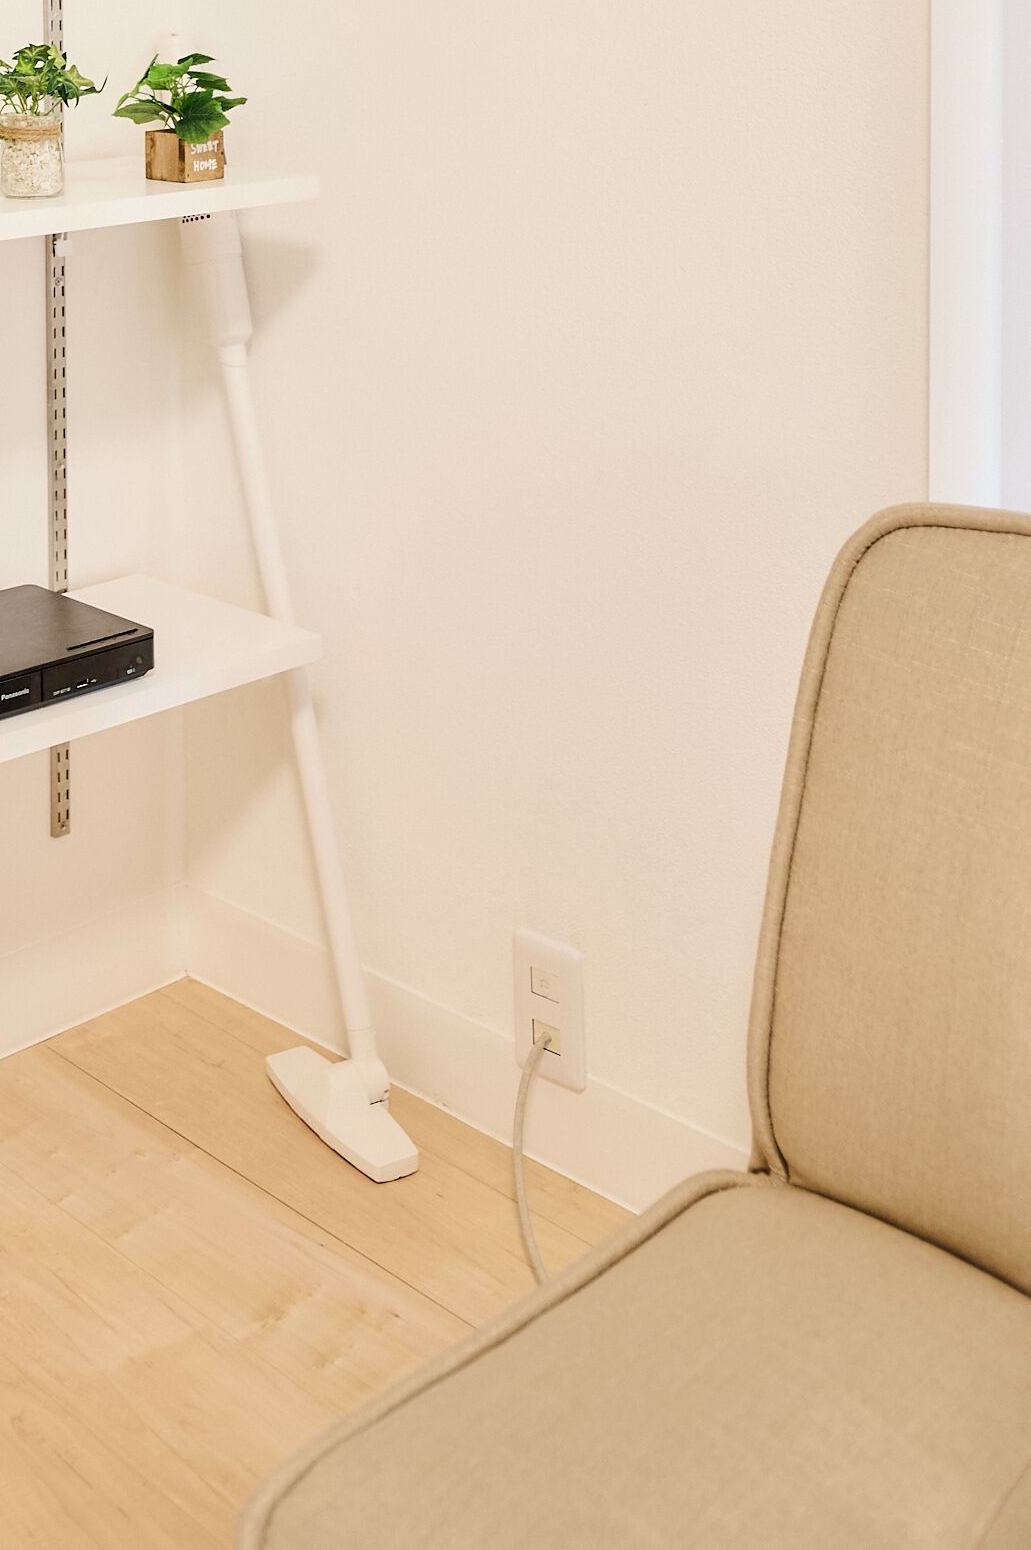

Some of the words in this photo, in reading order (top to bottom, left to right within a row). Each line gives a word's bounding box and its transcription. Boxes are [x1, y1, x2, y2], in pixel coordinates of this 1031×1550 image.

[190, 140, 219, 154] SWEET
[193, 158, 217, 172] HOME
[0, 688, 30, 701] Panasonic
